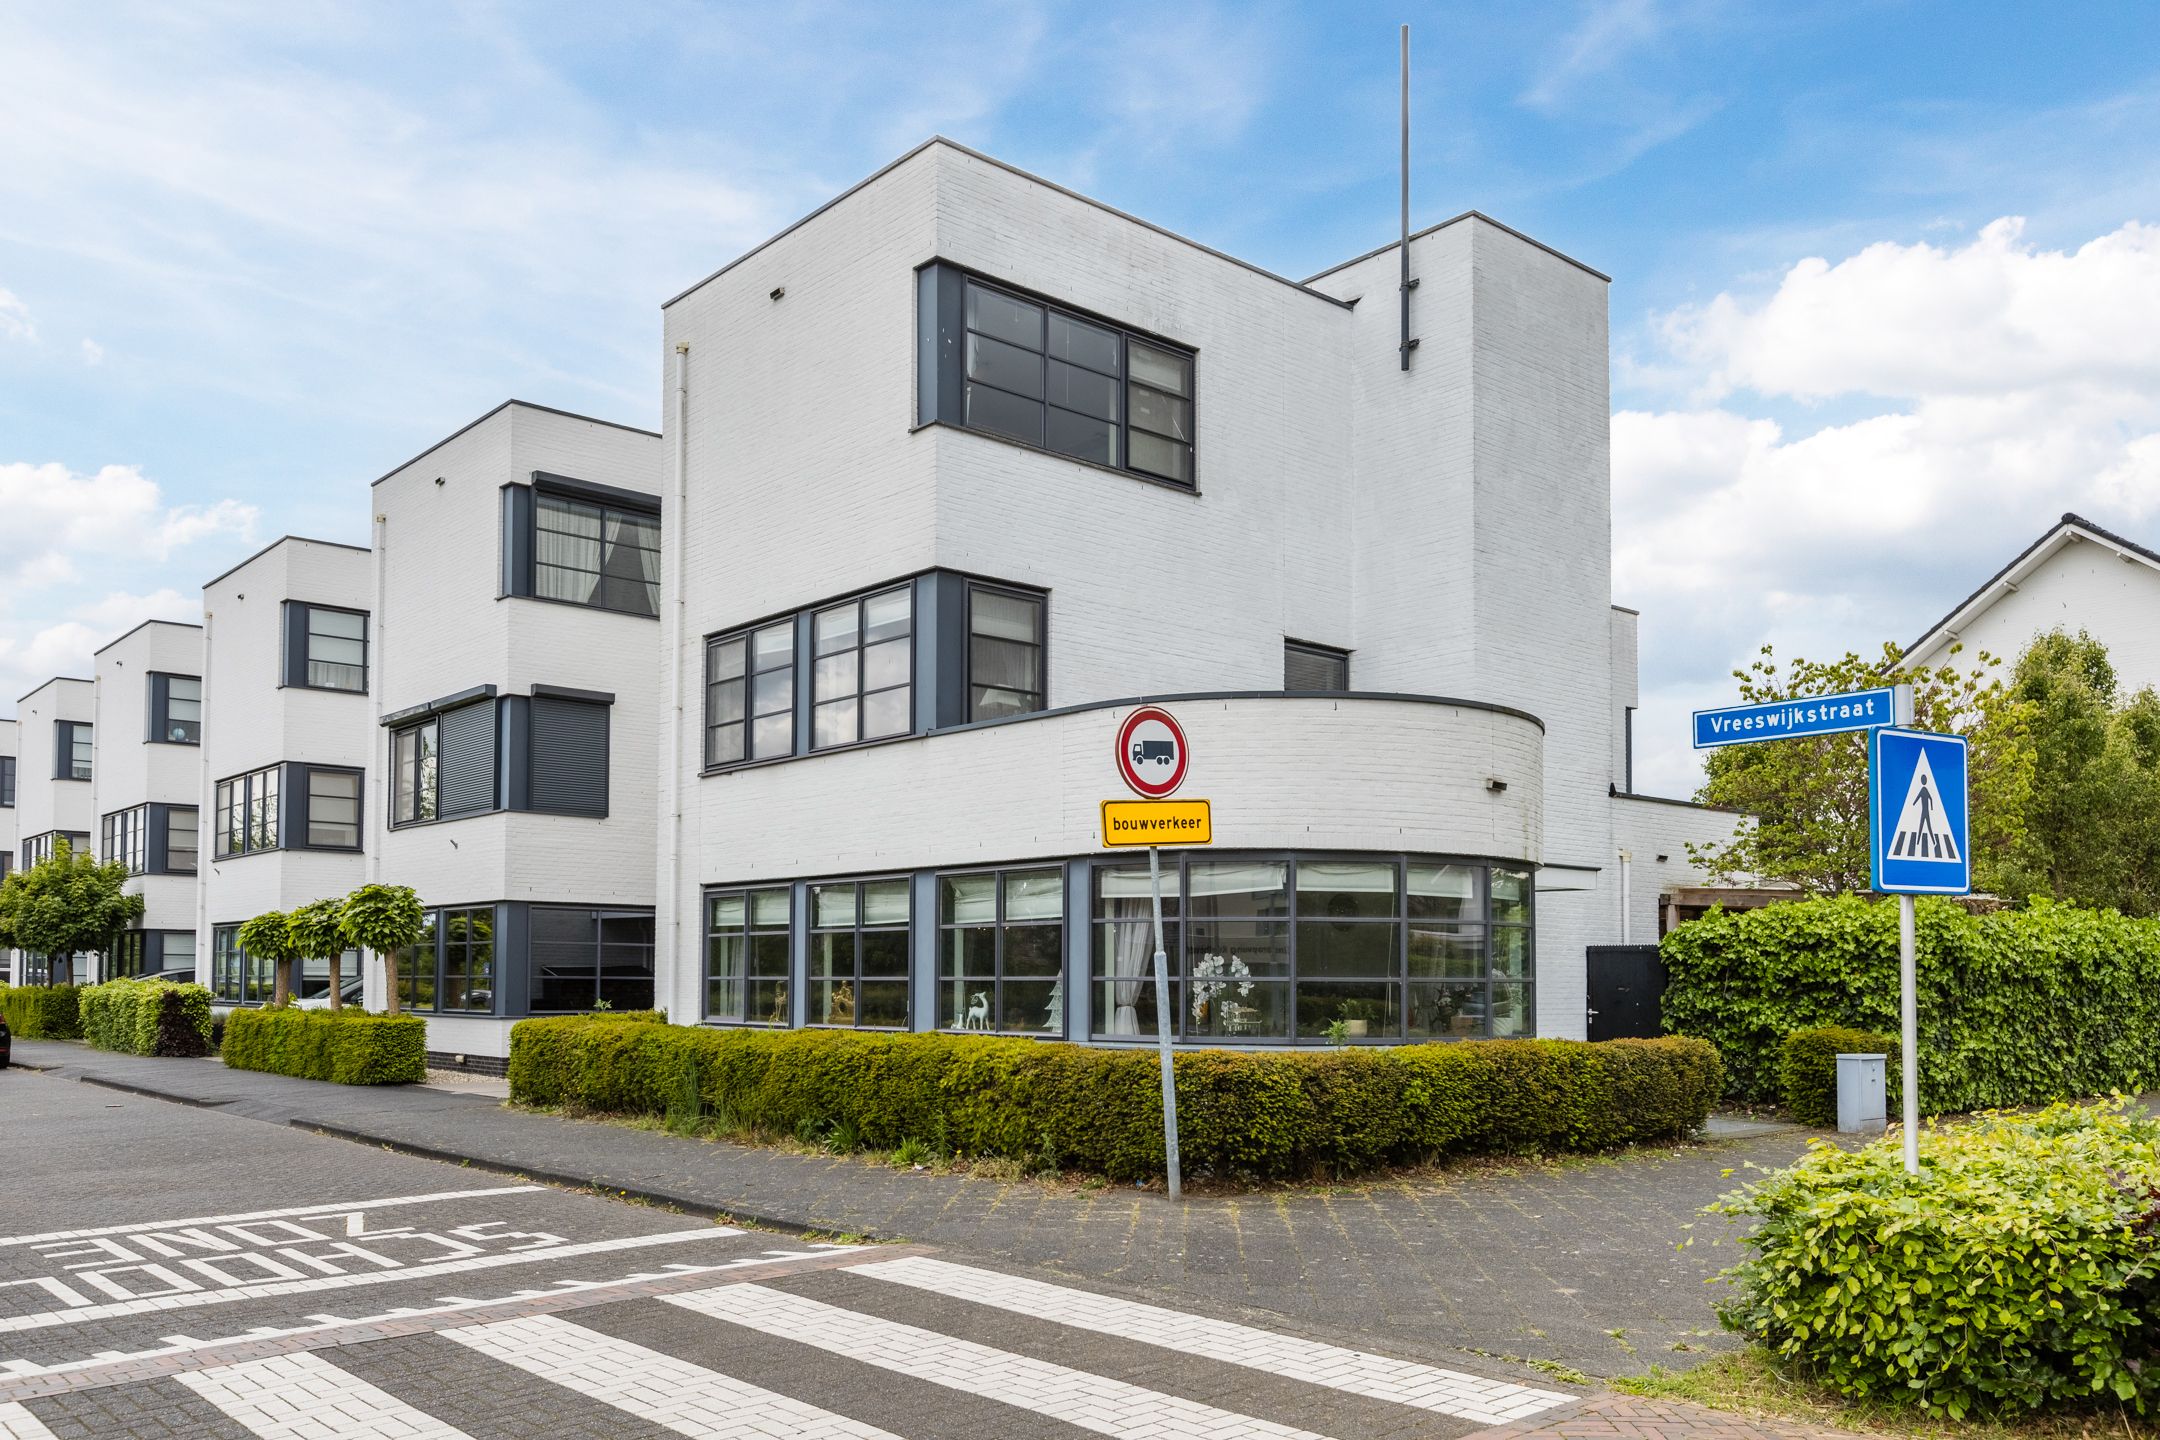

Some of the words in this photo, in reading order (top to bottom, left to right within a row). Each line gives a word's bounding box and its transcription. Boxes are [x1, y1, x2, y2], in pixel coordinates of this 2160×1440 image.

[1710, 698, 1875, 733] Vreeswijkstraat
[1113, 816, 1202, 831] bouwverkeer
[0, 1221, 570, 1307] SCHOOL
[30, 1212, 416, 1270] ZONE
